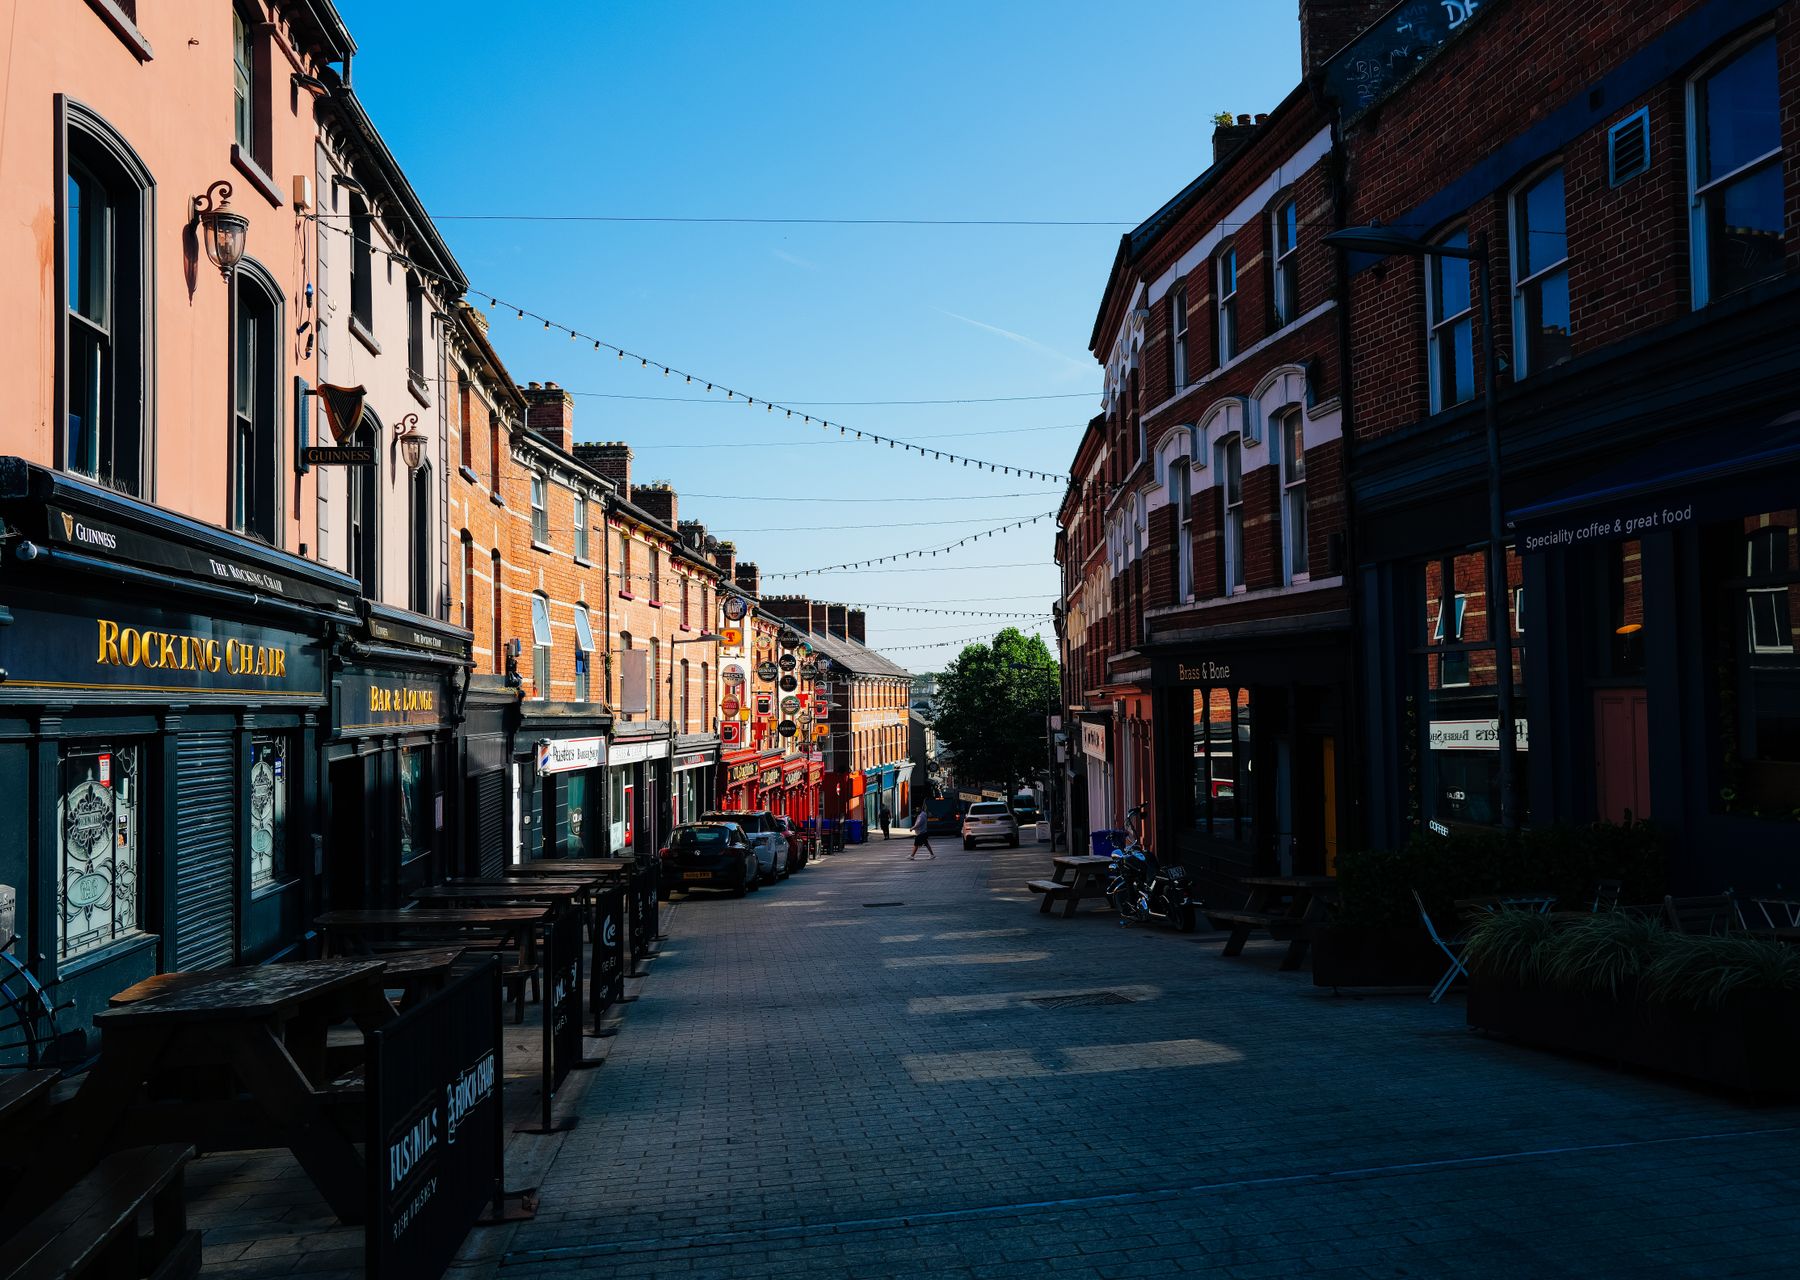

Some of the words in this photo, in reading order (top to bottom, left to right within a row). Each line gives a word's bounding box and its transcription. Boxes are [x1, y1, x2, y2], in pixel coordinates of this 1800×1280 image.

[308, 449, 370, 462] GUINNESS
[76, 523, 116, 549] GUINNESS
[1526, 528, 1574, 551] Speciality
[1577, 520, 1610, 541] coffee
[1613, 518, 1622, 533] &
[1626, 512, 1658, 534] great
[1662, 504, 1692, 525] food
[209, 559, 228, 577] THE
[229, 561, 264, 586] ROCKING
[264, 574, 284, 593] CHAIR
[96, 619, 222, 674] ROCKING
[226, 638, 286, 678] CHAIR
[1178, 663, 1200, 681] Brass
[1201, 662, 1208, 680] &
[1209, 661, 1231, 680] Bone
[370, 686, 391, 712] BAR
[393, 689, 401, 712] &
[402, 687, 433, 712] LOUNGE
